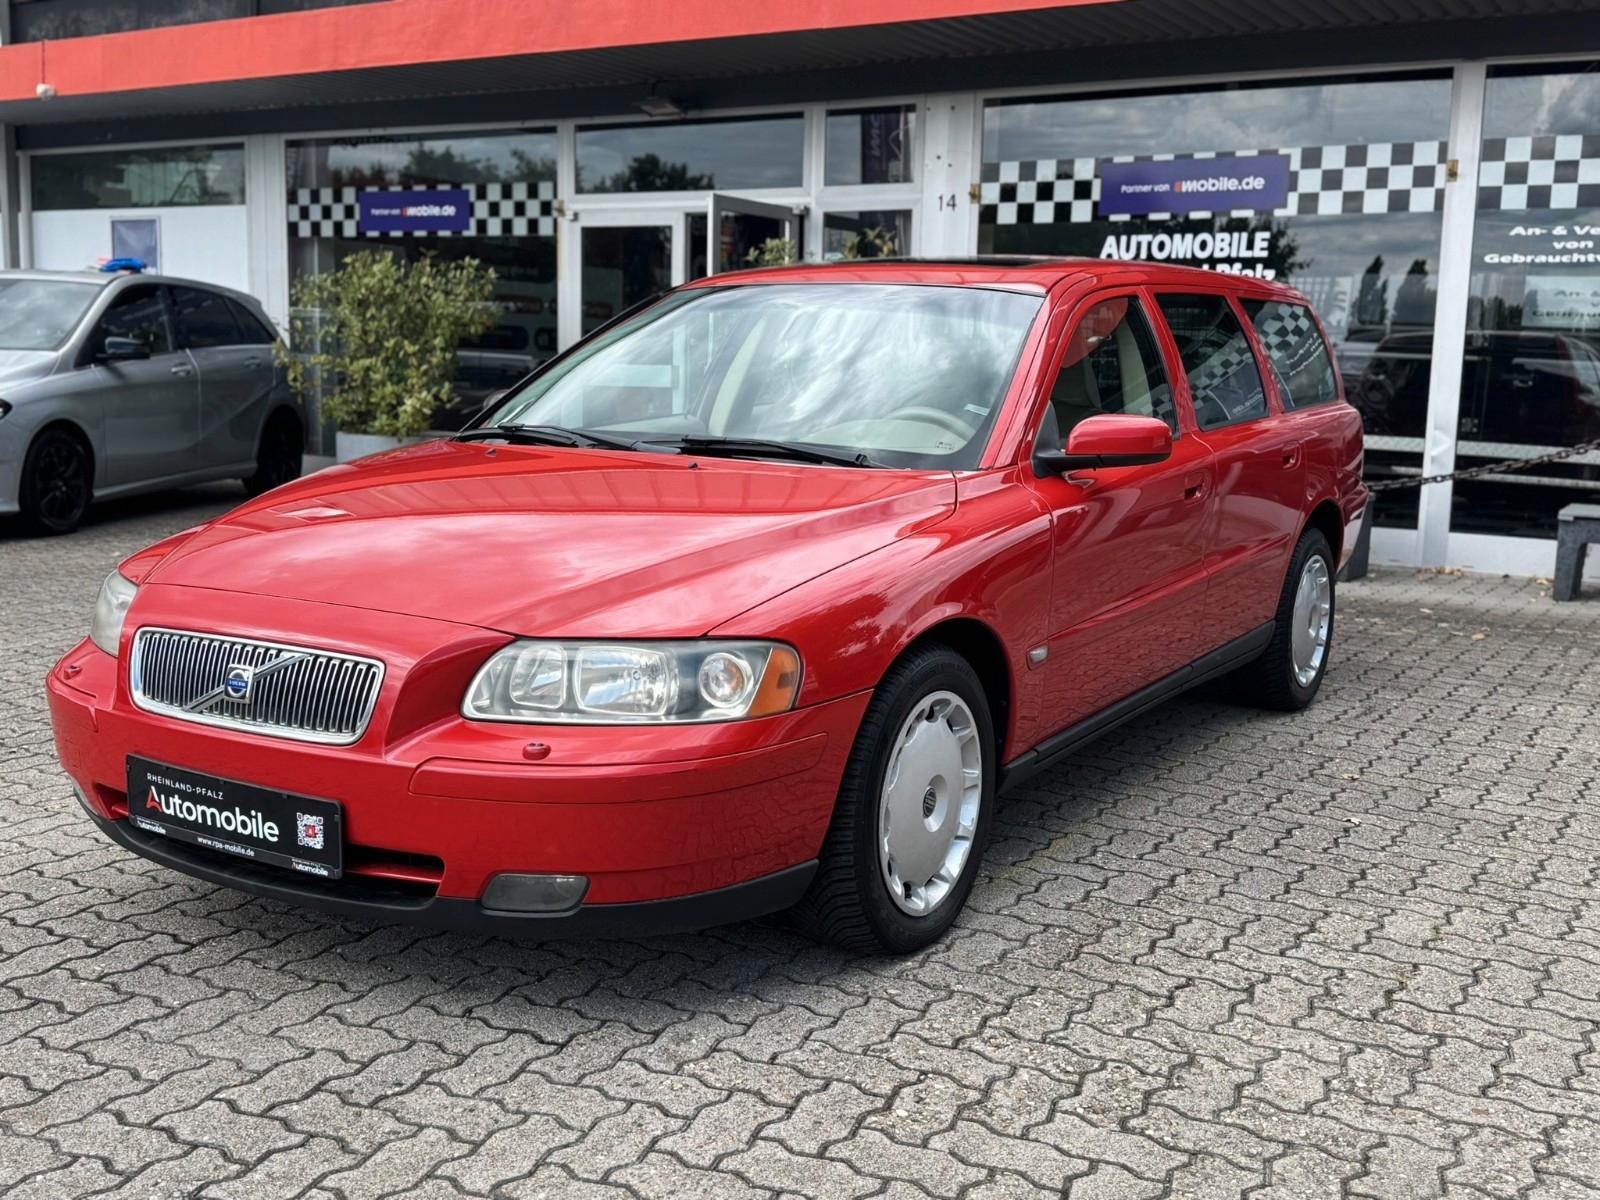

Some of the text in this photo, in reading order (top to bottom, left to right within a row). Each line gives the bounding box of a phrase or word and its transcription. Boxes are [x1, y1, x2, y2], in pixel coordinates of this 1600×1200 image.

[1121, 176, 1266, 194] Partner von mobile.de
[938, 193, 958, 212] 14
[1508, 225, 1548, 236] An-
[1551, 225, 1568, 236] &
[1100, 231, 1271, 260] AUTOMOBILE
[1552, 240, 1595, 250] von
[146, 772, 224, 800] RHEINLAND-PFALZ
[146, 785, 280, 843] Automobile
